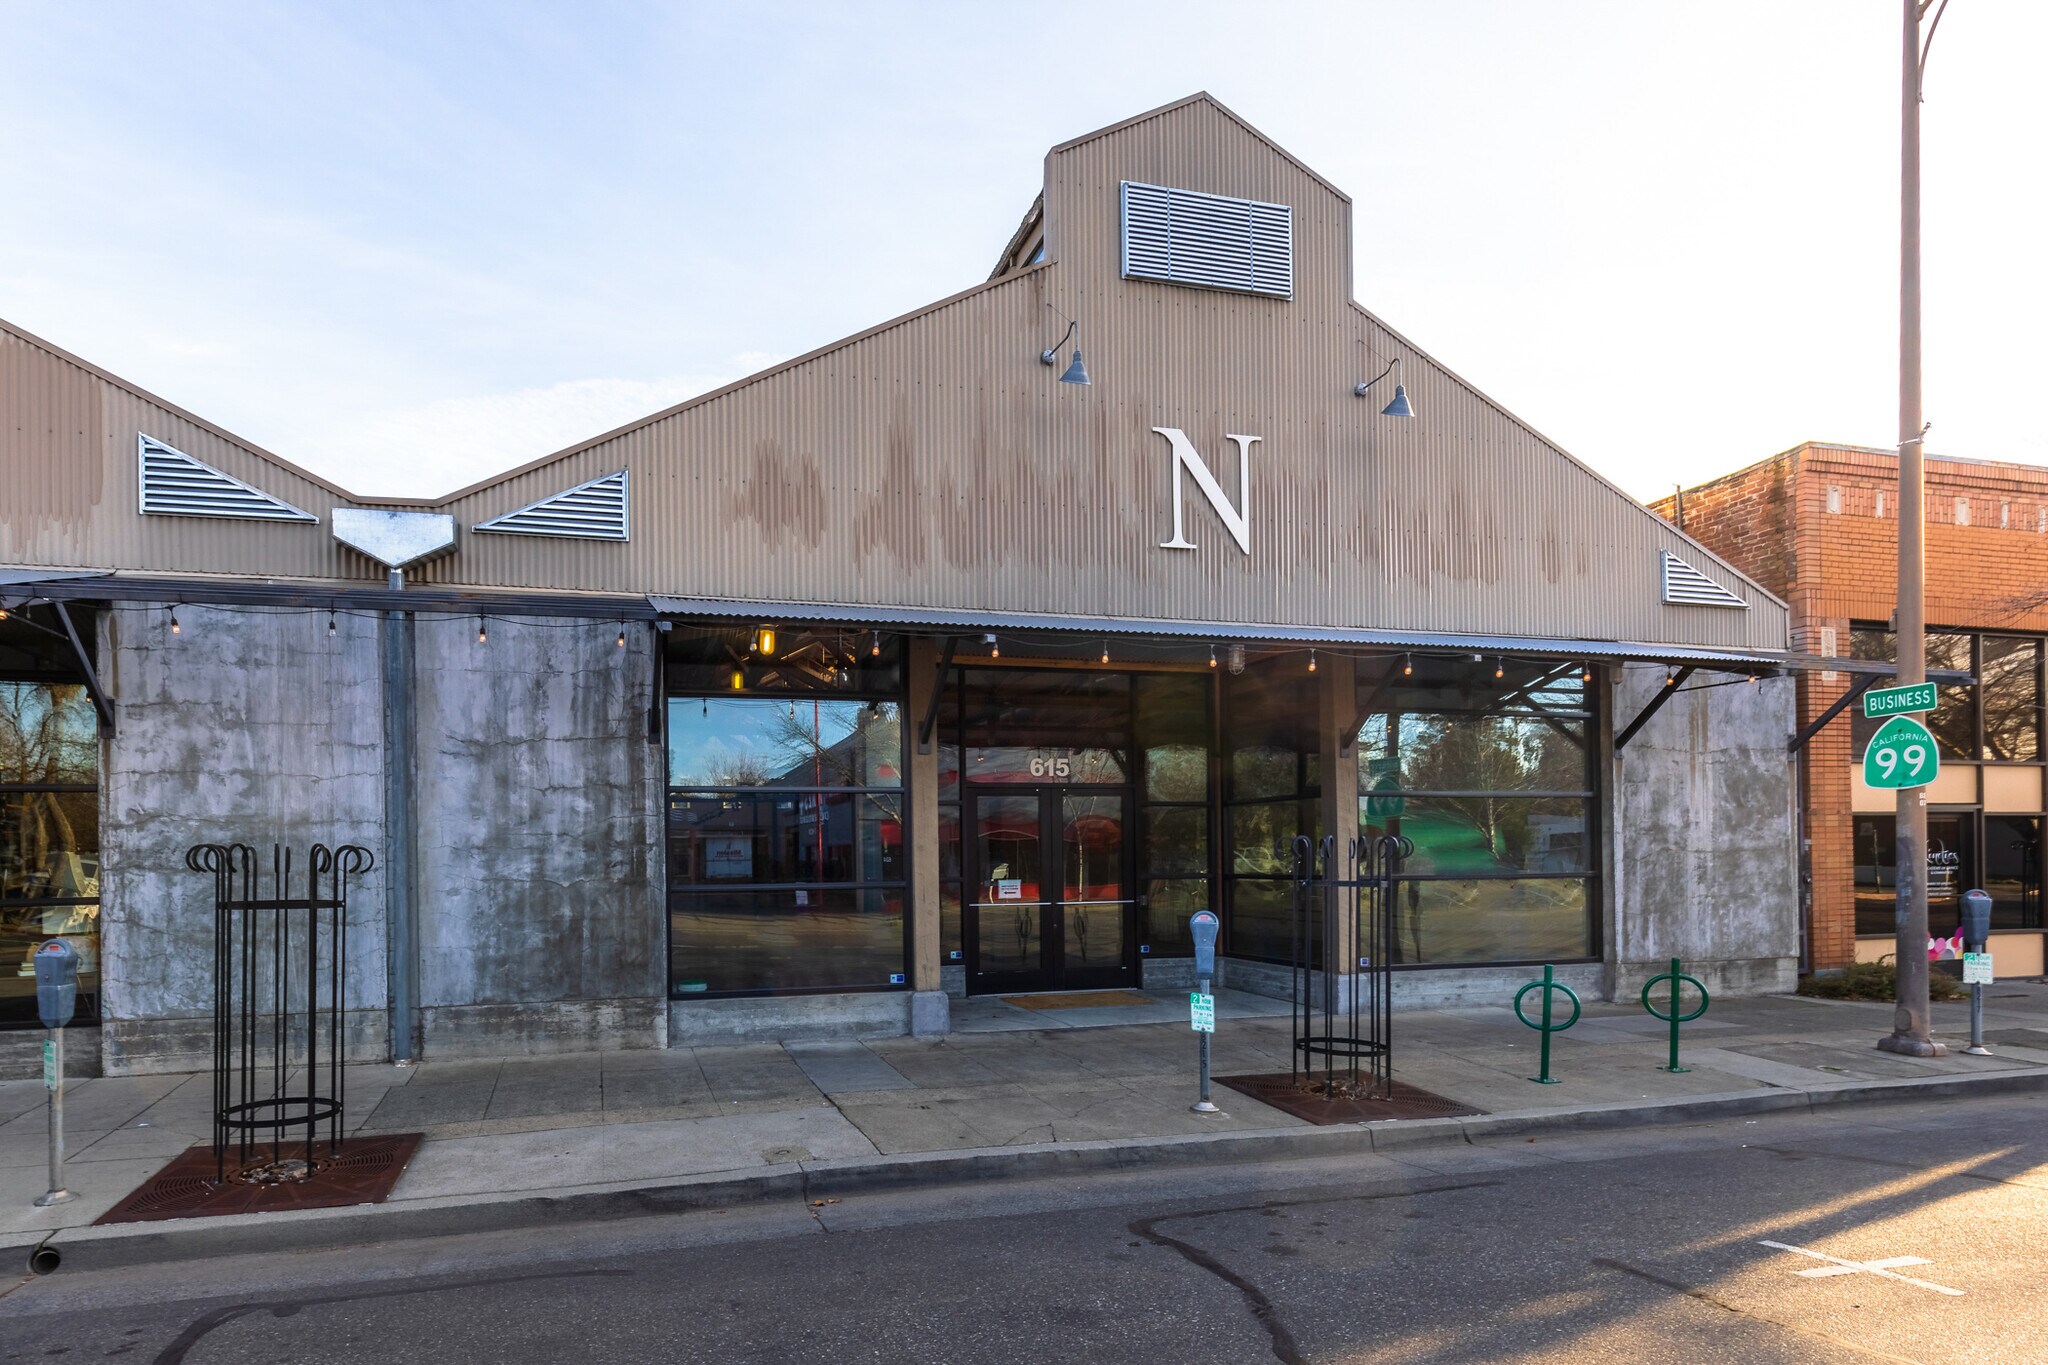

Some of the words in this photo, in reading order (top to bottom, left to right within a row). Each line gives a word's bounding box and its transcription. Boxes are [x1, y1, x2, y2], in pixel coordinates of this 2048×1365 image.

[1152, 426, 1262, 555] N
[1870, 689, 1930, 711] BUSINESS
[1872, 733, 1928, 749] CALIFORNIA
[1030, 757, 1069, 777] 615
[1875, 744, 1926, 779] 99
[1192, 994, 1198, 1003] 2
[1193, 1004, 1212, 1012] PARKING
